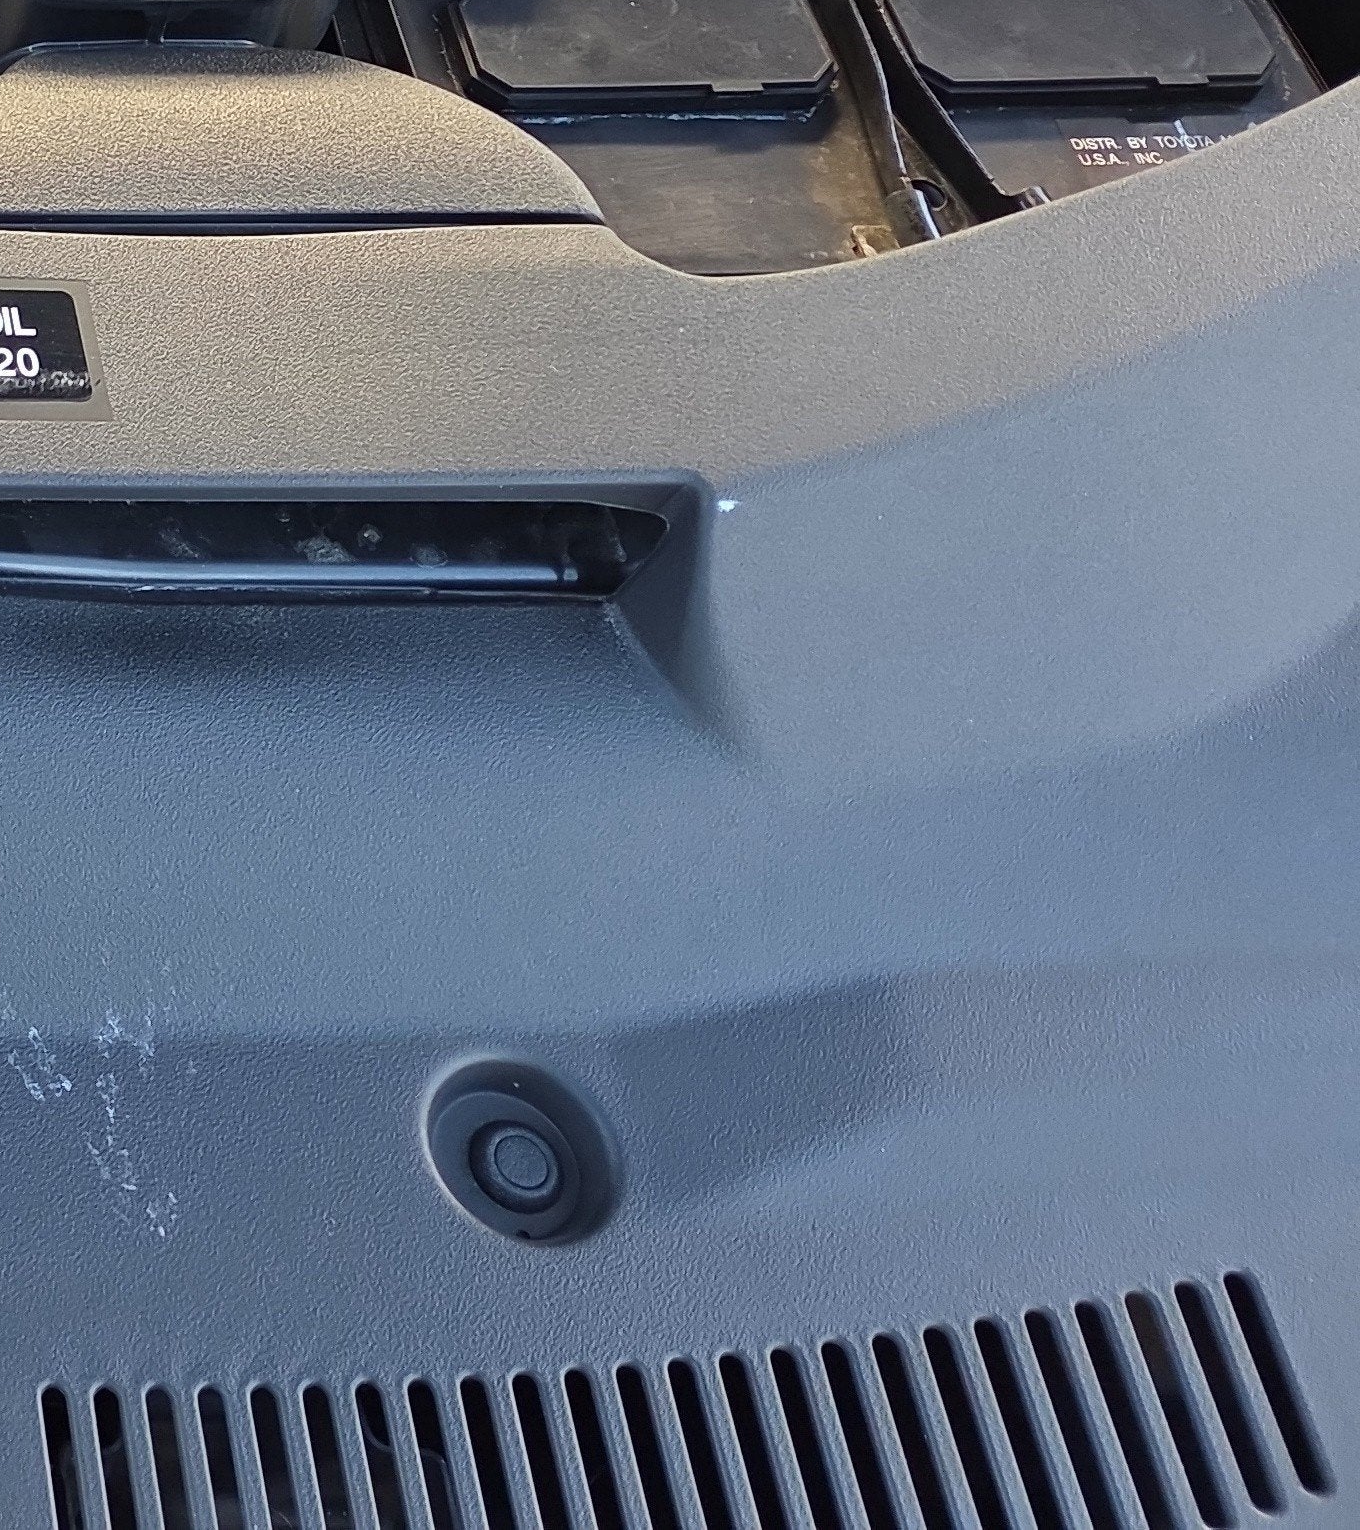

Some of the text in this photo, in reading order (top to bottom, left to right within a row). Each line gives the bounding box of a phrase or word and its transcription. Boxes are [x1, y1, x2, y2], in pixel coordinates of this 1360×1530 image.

[1069, 137, 1122, 150] DISTR.
[1126, 137, 1148, 149] BY
[1153, 135, 1215, 149] TOYOTA
